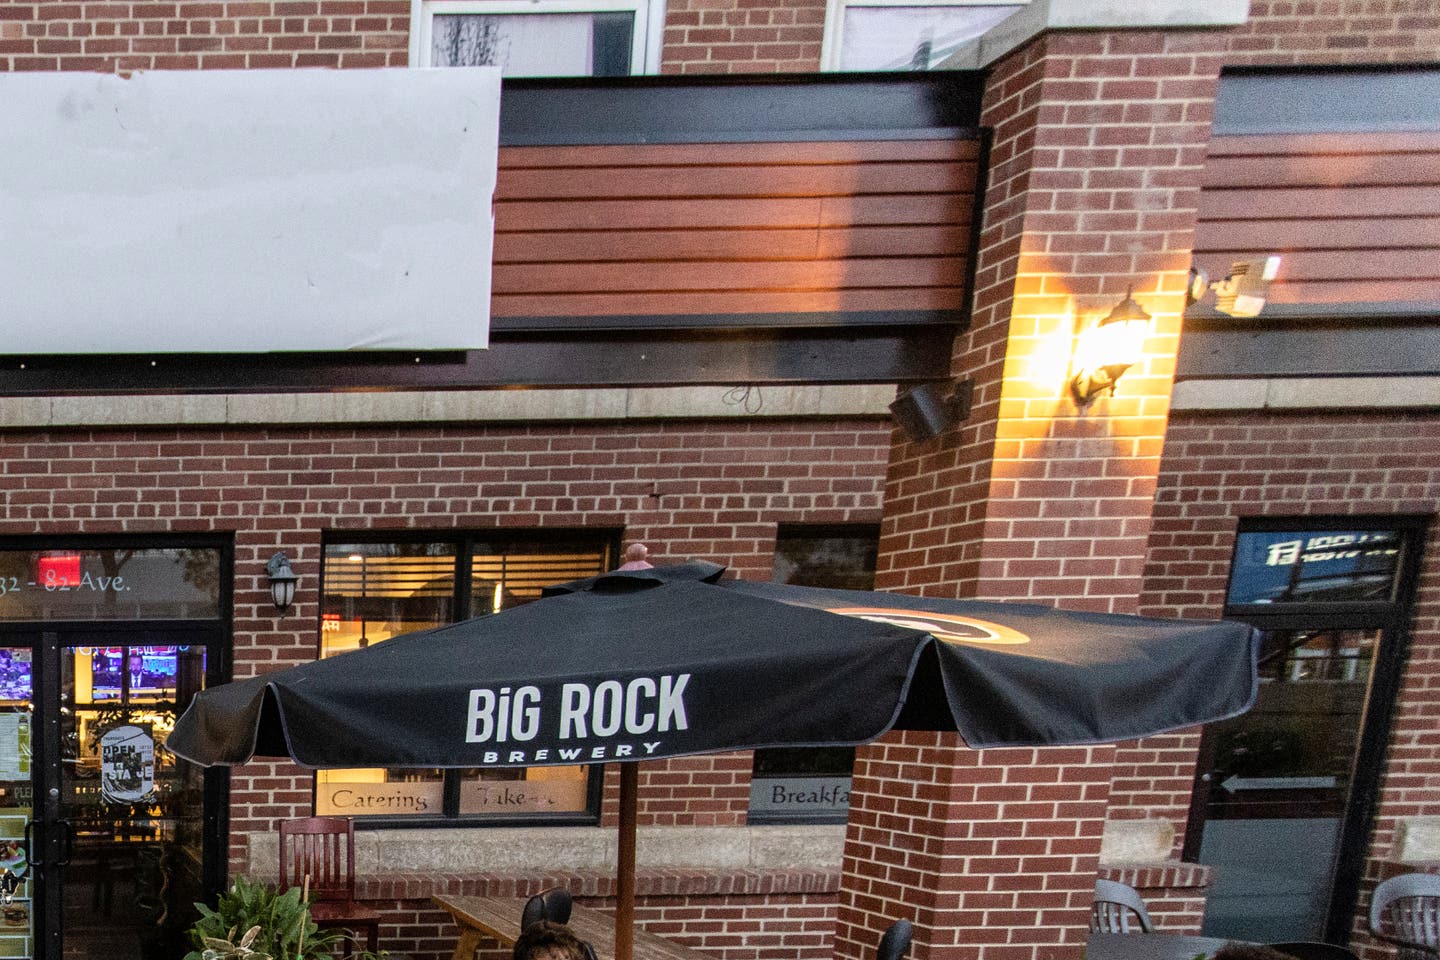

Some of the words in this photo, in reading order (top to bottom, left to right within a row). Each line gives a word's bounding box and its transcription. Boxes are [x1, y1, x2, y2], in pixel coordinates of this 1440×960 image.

[45, 569, 71, 592] 82
[76, 571, 131, 592] Ave.
[558, 673, 692, 740] ROCK
[103, 745, 136, 755] OPEN
[482, 741, 662, 763] BREWERY
[331, 789, 428, 811] Catering
[771, 785, 850, 807] Breakfa
